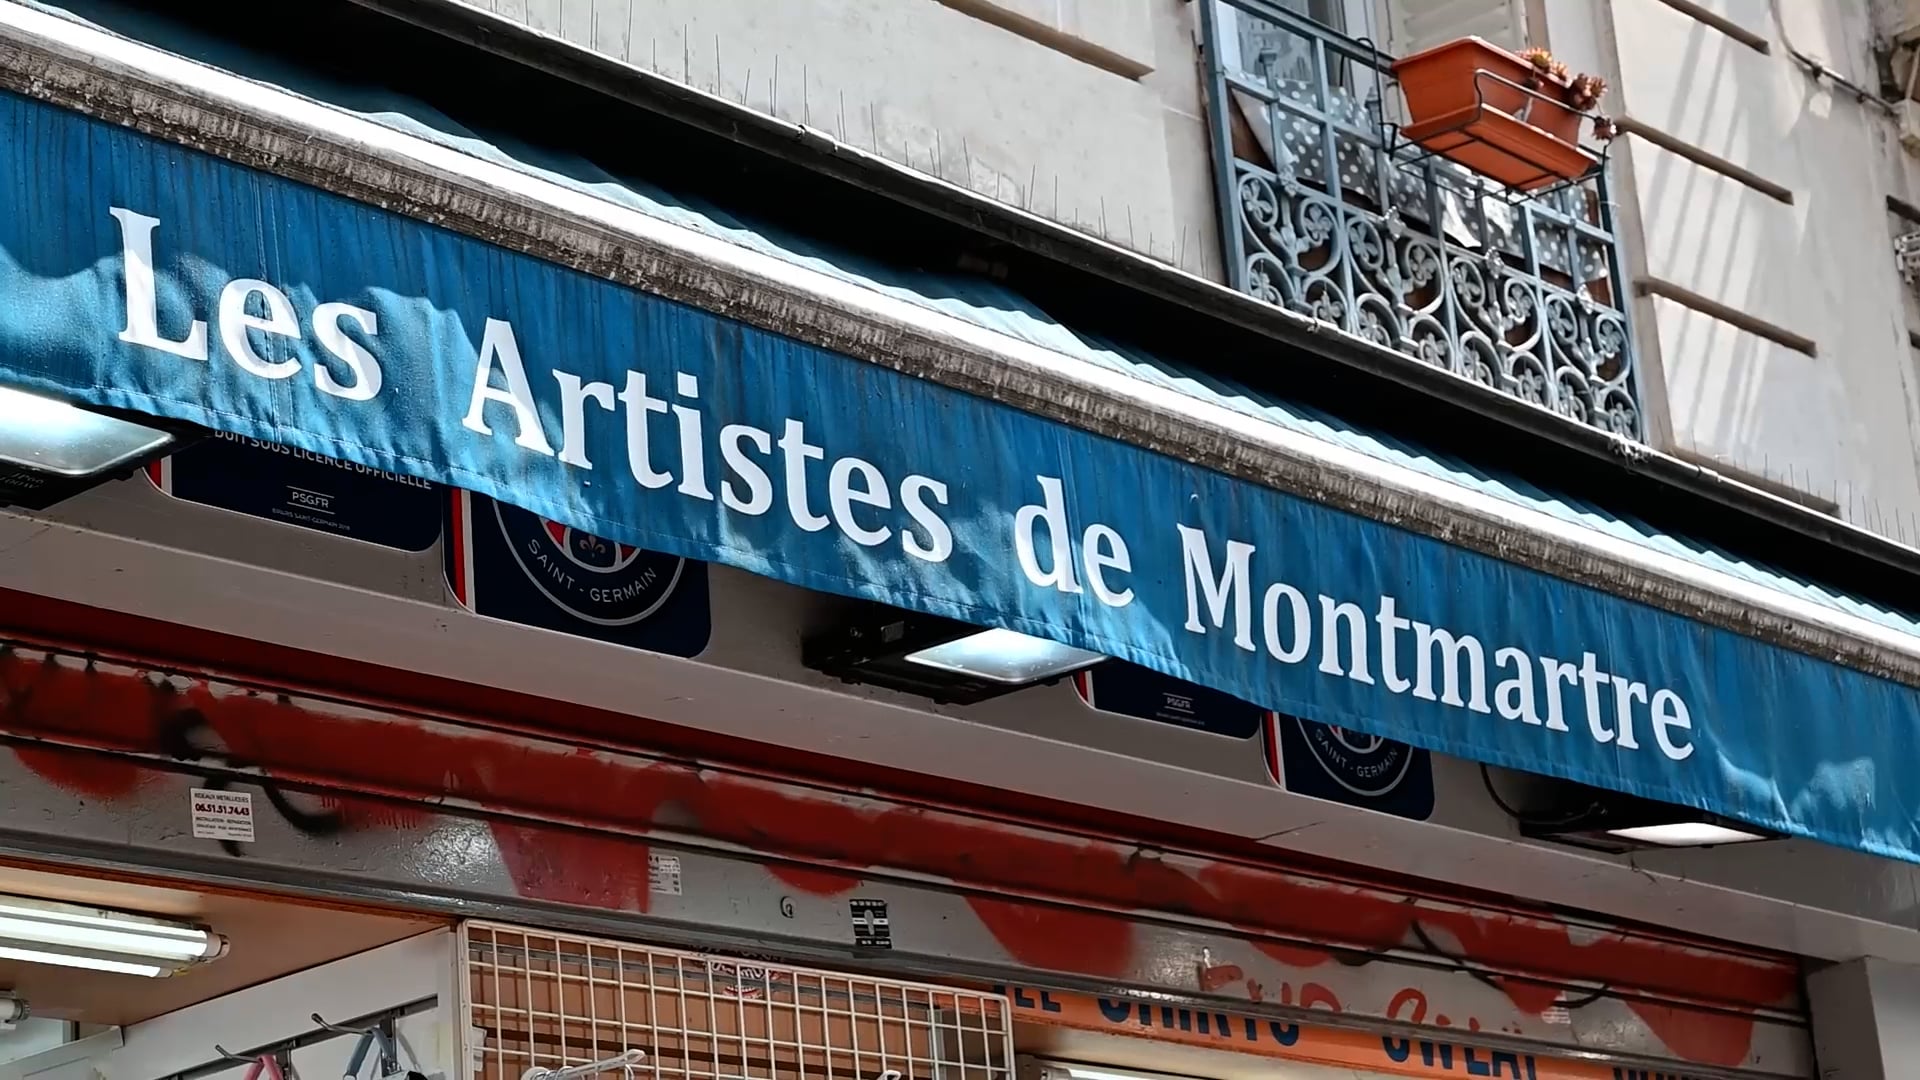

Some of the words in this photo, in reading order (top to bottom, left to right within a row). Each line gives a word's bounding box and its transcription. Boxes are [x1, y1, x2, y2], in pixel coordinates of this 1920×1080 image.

[109, 206, 382, 402] Les
[461, 317, 953, 563] Artistes
[1013, 474, 1134, 608] de
[1176, 523, 1694, 761] Montmartre
[528, 538, 575, 590] SAINT
[589, 567, 657, 603] GERMAIN
[1356, 749, 1398, 778] GERMAIN
